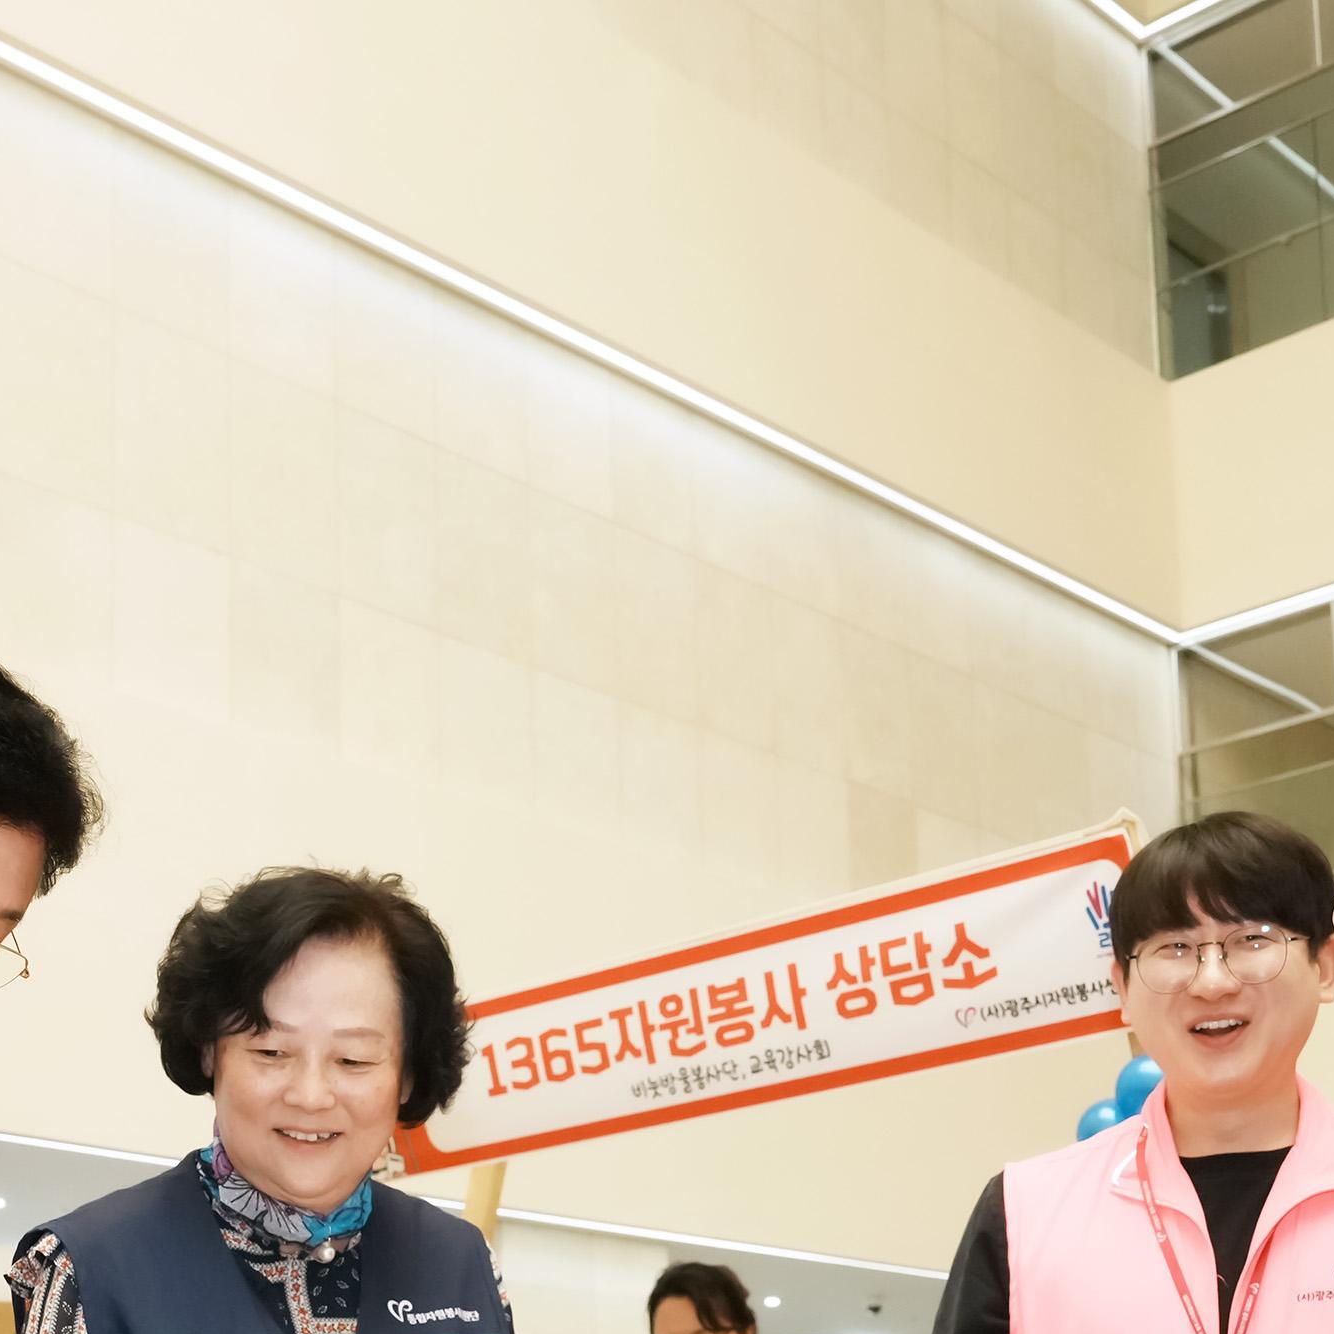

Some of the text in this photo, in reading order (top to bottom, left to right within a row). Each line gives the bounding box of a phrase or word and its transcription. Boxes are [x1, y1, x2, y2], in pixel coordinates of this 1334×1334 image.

[481, 922, 999, 1097] 1365자원봉사 상담소
[631, 1039, 832, 1099] 비눗방울봉사단, 교육강사회
